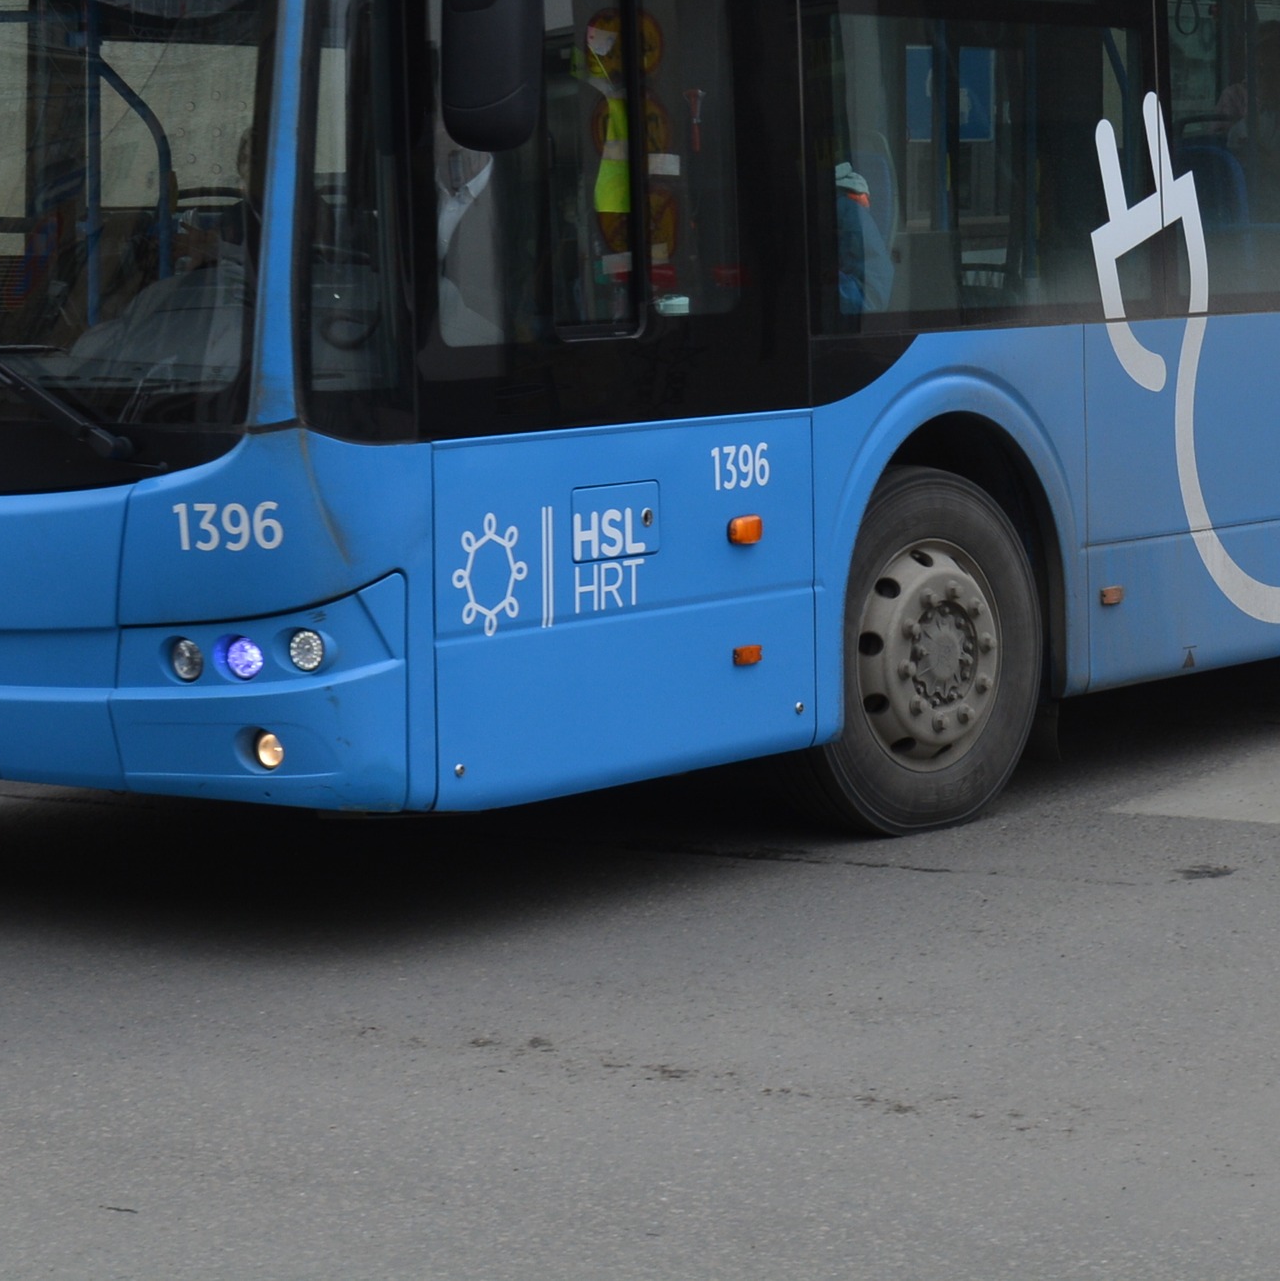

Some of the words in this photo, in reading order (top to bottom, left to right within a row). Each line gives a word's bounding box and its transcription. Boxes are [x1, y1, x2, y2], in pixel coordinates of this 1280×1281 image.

[710, 442, 770, 491] 1396
[172, 501, 284, 552] 1396
[572, 507, 647, 561] HSL
[574, 558, 645, 614] HRT
